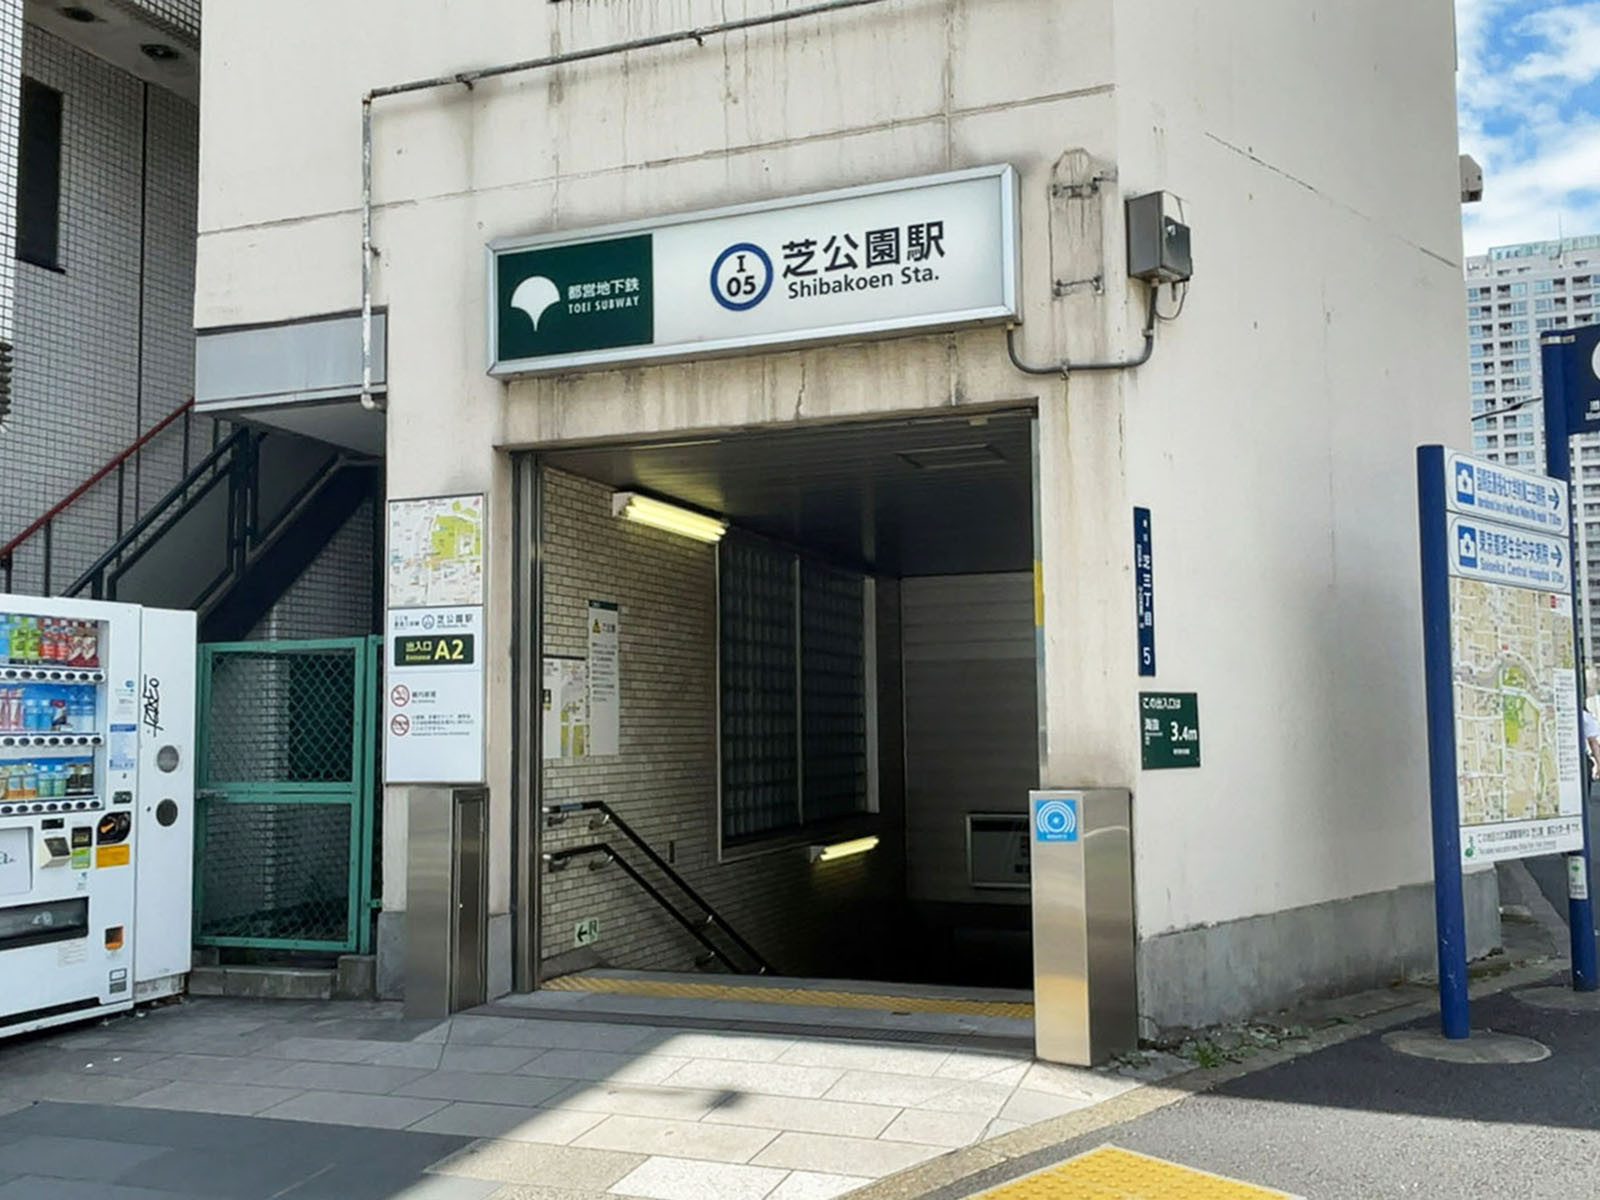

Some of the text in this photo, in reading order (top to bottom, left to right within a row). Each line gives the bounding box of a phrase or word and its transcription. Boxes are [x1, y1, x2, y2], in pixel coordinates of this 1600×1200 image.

[782, 221, 945, 279] 芝公園駅
[736, 255, 746, 273] I
[568, 277, 640, 300] 都営地下鉄
[726, 275, 756, 297] 05
[788, 265, 939, 300] Shibakoen Sta.
[568, 296, 639, 314] TOEI SUBWAY
[405, 641, 432, 652] 出入口
[434, 639, 464, 660] A2
[1143, 646, 1151, 665] 5
[1170, 721, 1198, 741] 3.4m
